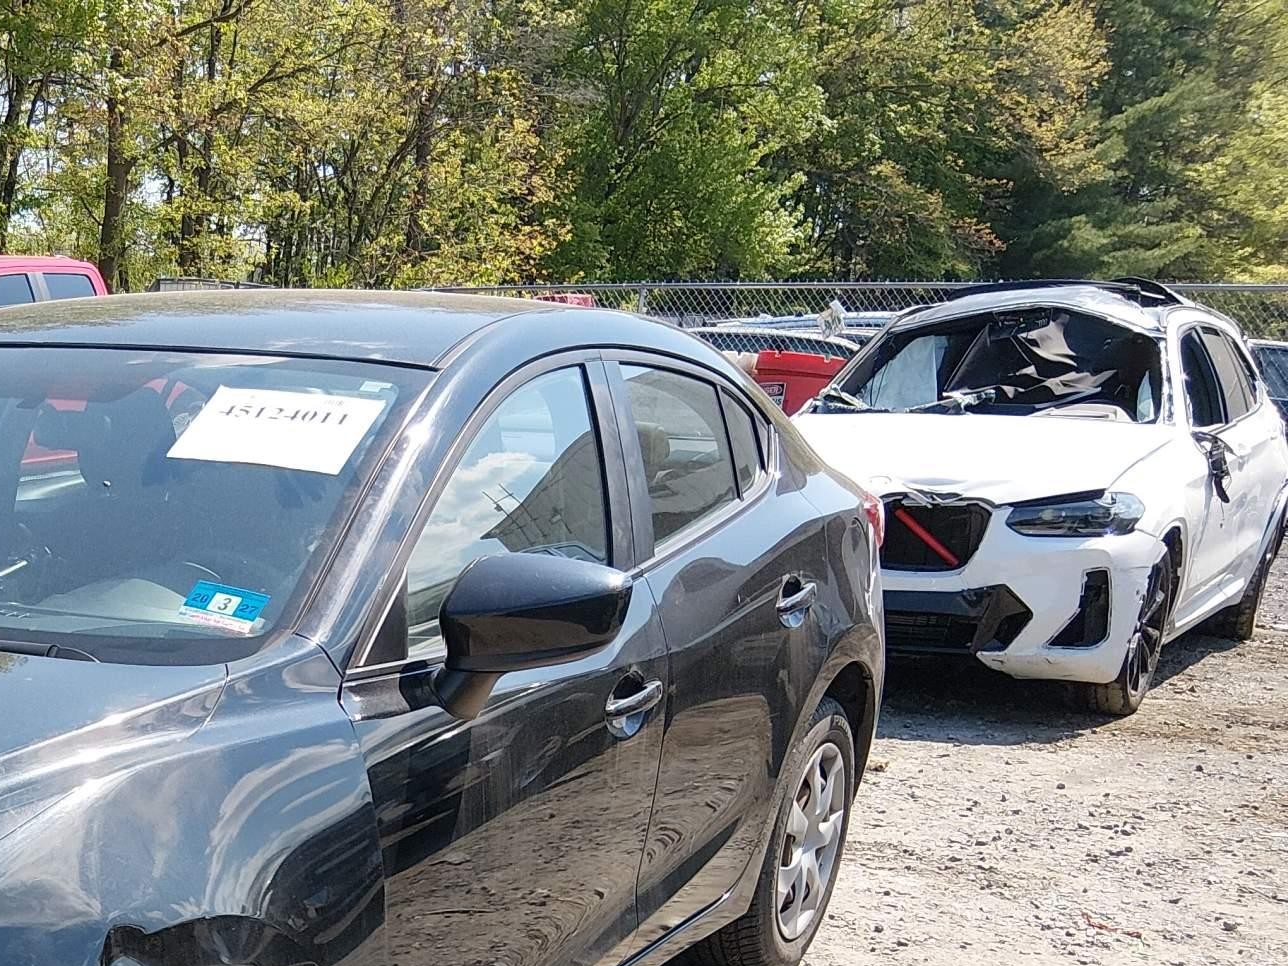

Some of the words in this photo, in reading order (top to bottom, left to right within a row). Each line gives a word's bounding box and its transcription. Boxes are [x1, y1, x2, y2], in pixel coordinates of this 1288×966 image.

[218, 403, 350, 425] 45124011
[192, 592, 210, 604] 20
[217, 597, 232, 611] 3
[238, 603, 259, 616] 27
